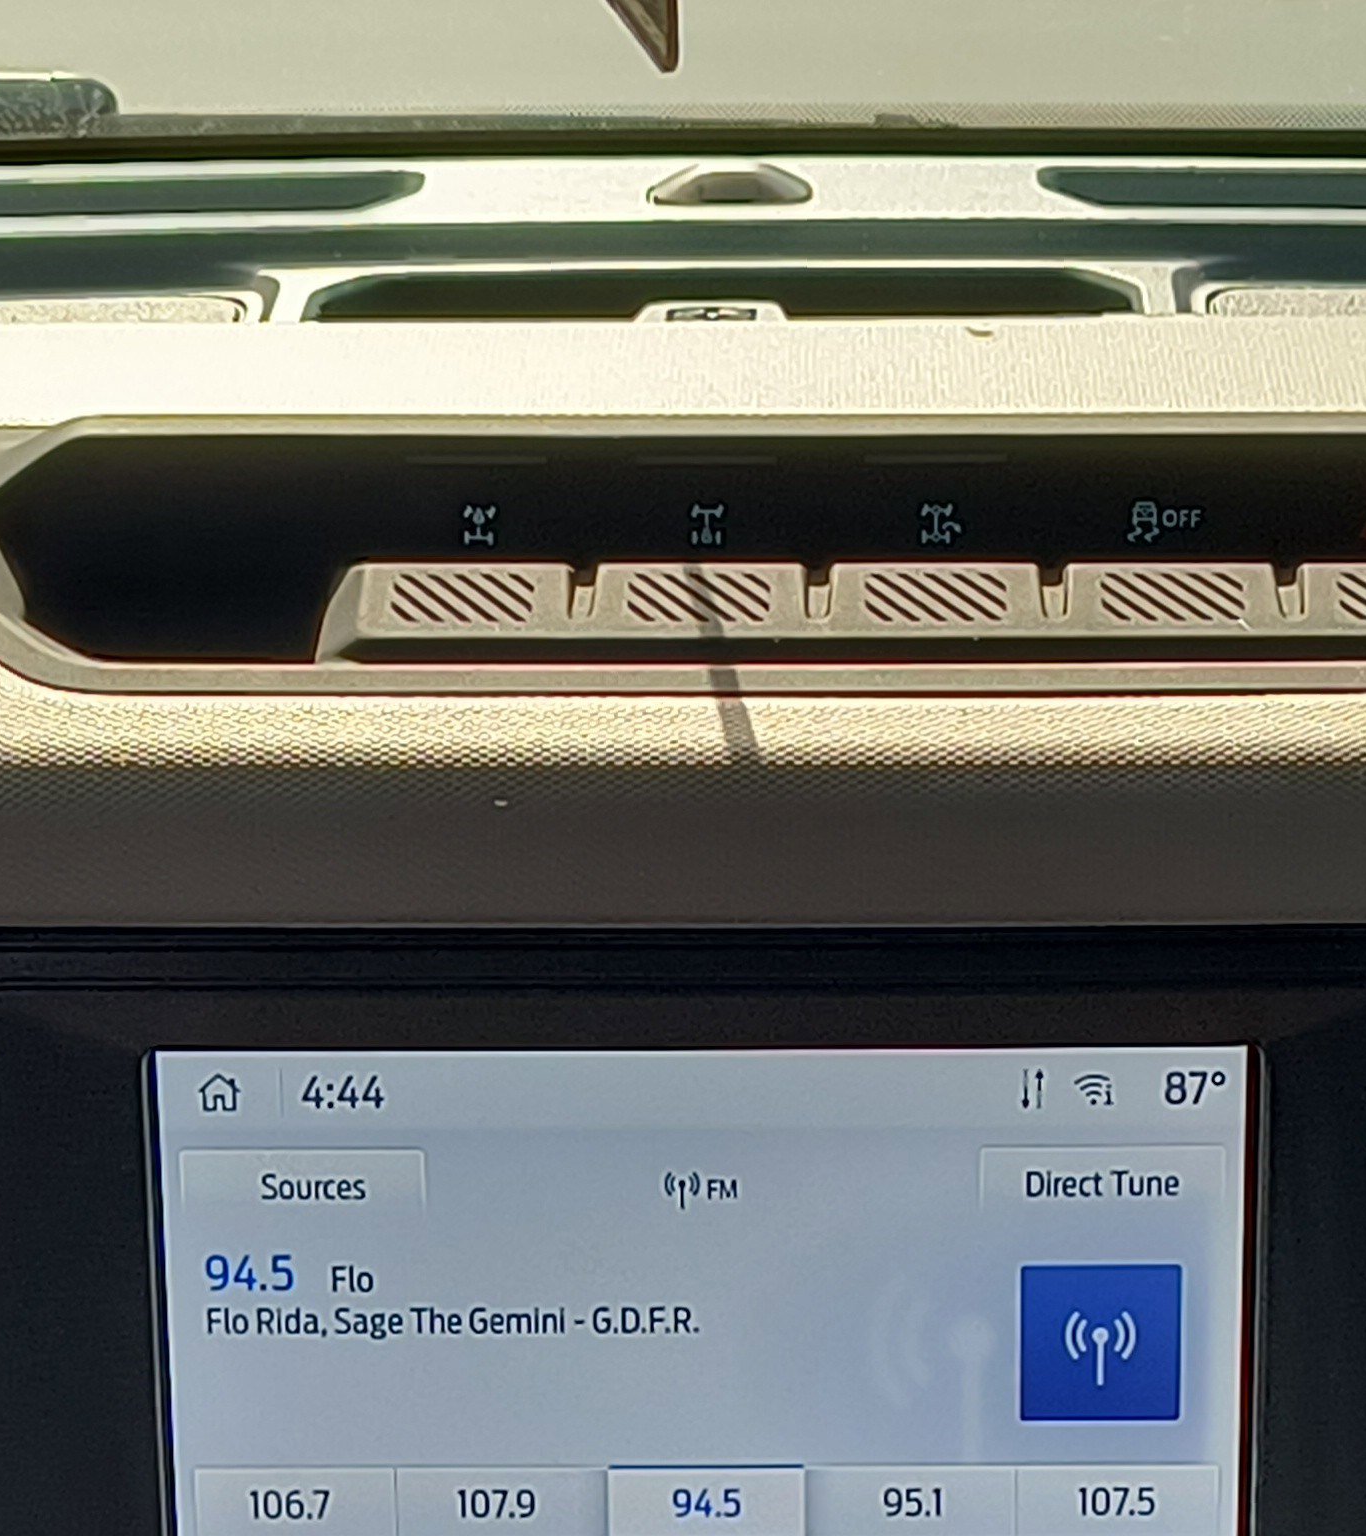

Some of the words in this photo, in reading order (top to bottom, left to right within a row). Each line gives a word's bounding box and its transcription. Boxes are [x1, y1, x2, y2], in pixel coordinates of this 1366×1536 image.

[1162, 508, 1202, 529] OFF
[301, 1075, 385, 1110] 4:44
[1164, 1071, 1227, 1106] 87°
[260, 1173, 367, 1201] Sources
[707, 1179, 738, 1201] FM
[1025, 1170, 1103, 1198] Direct
[1109, 1169, 1180, 1197] Tune
[204, 1254, 295, 1293] 94.5
[331, 1265, 375, 1294] Flo
[206, 1307, 249, 1336] Flo
[256, 1307, 328, 1339] Rida,
[333, 1308, 404, 1340] Sage
[410, 1307, 463, 1336] The
[467, 1306, 566, 1336] Gemini
[591, 1306, 700, 1336] G.D.F.R.
[248, 1488, 331, 1520] 106.7
[456, 1488, 537, 1520] 107.9
[672, 1487, 742, 1519] 94.5
[882, 1487, 943, 1518] 95.1
[1077, 1486, 1156, 1516] 107.5
